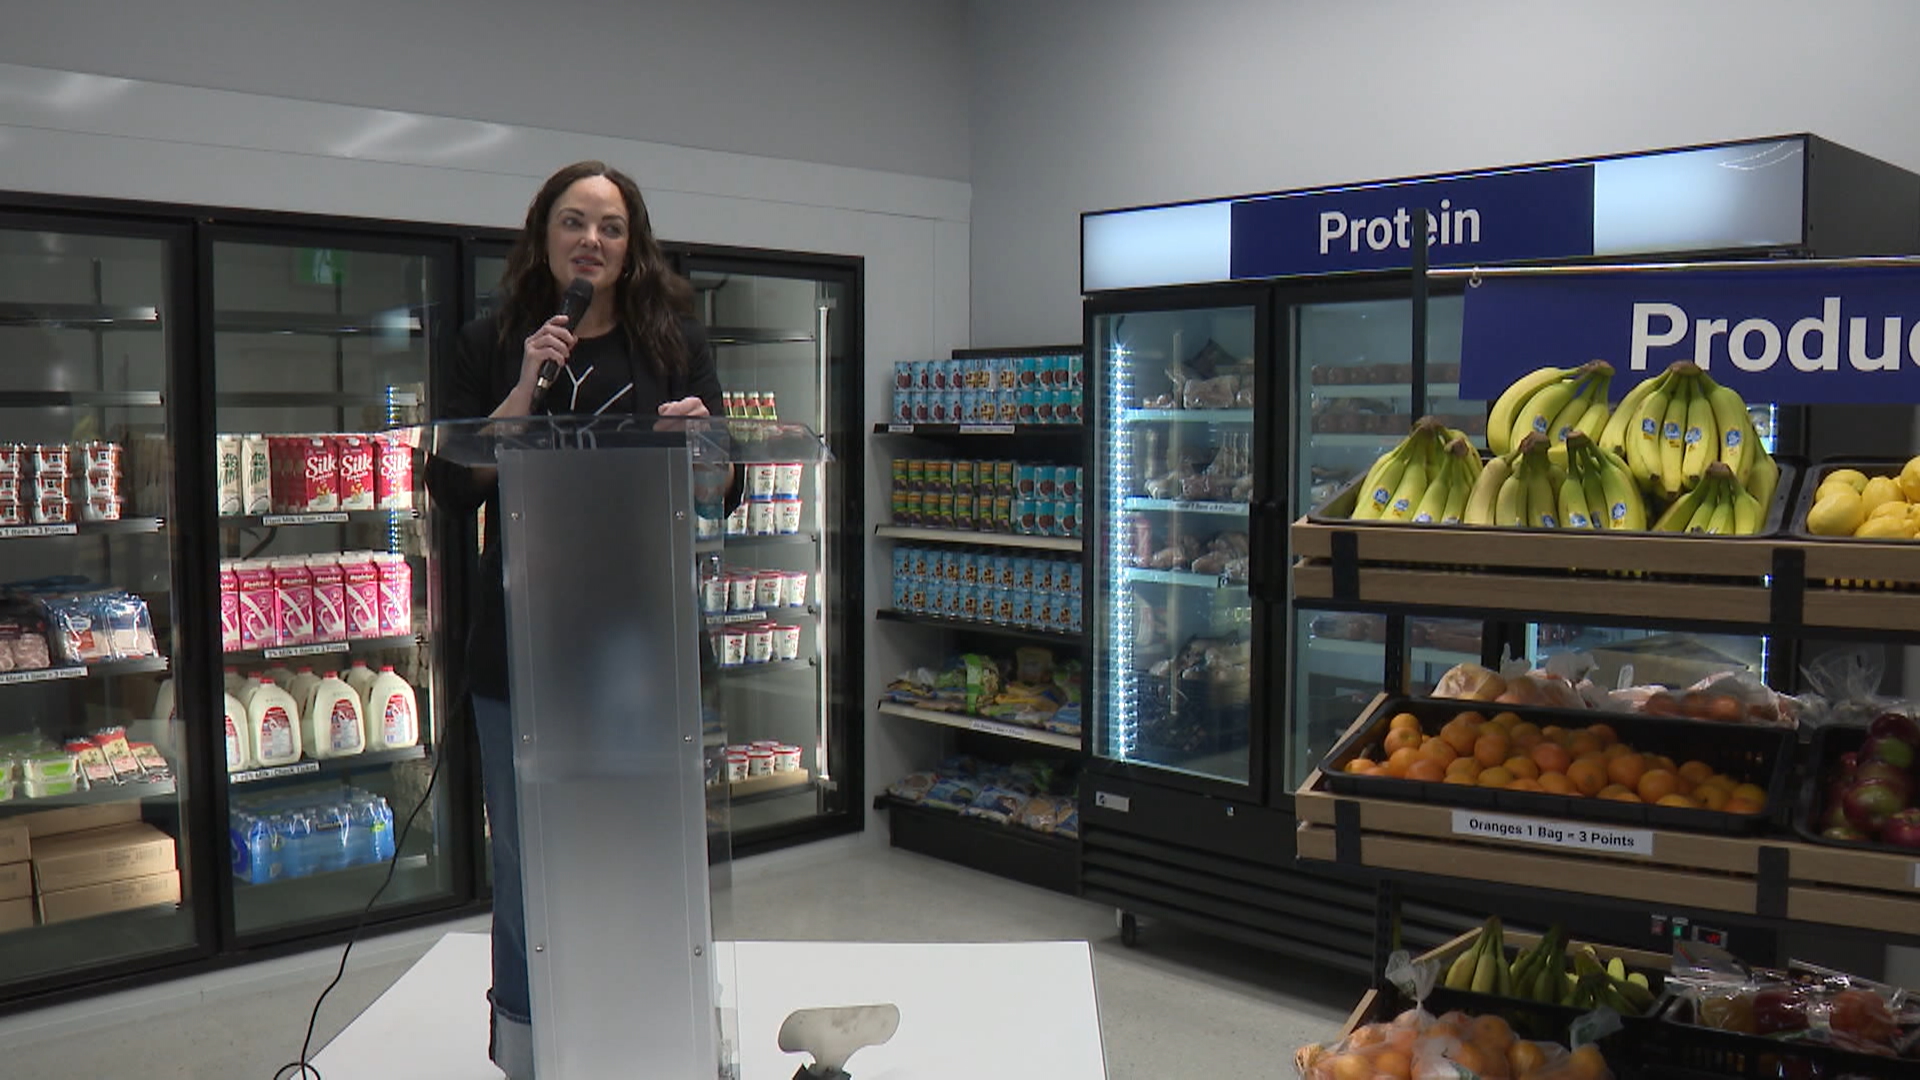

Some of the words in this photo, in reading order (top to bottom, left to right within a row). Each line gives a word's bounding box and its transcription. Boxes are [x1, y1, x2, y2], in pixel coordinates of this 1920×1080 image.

[1630, 297, 1920, 372] Produ
[305, 453, 337, 479] Silk
[340, 452, 374, 477] Silk
[381, 452, 411, 477] Silk
[44, 526, 69, 535] Points
[1469, 818, 1522, 836] Oranges
[1527, 825, 1533, 836] 1
[1538, 826, 1563, 842] Bag
[1579, 831, 1587, 842] 3
[1591, 833, 1635, 847] Points
